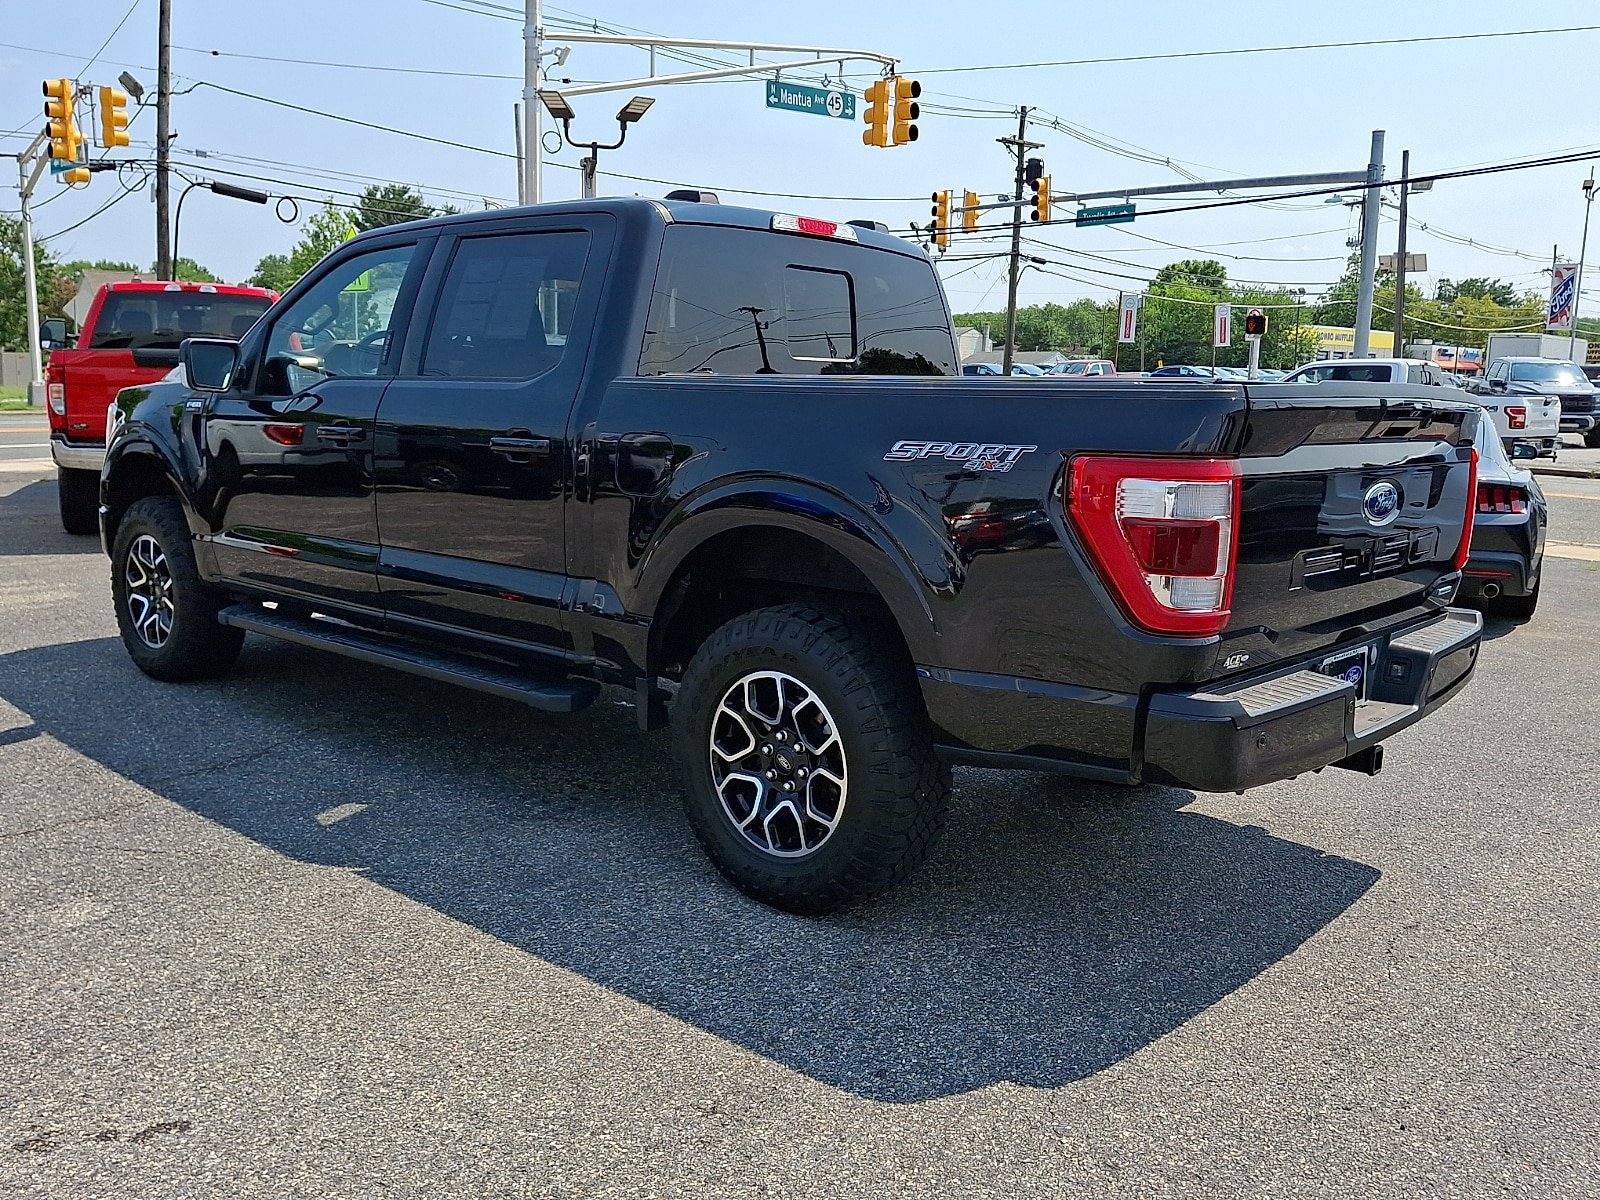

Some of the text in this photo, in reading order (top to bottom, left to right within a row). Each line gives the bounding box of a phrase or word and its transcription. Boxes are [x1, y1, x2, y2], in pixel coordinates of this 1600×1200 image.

[770, 84, 852, 111] N Mantua Ave 45 S
[1551, 280, 1573, 313] Ford
[882, 440, 1038, 462] SPORT
[1374, 491, 1394, 513] Ford
[1223, 654, 1243, 668] ACE
[1348, 669, 1359, 682] Ford
